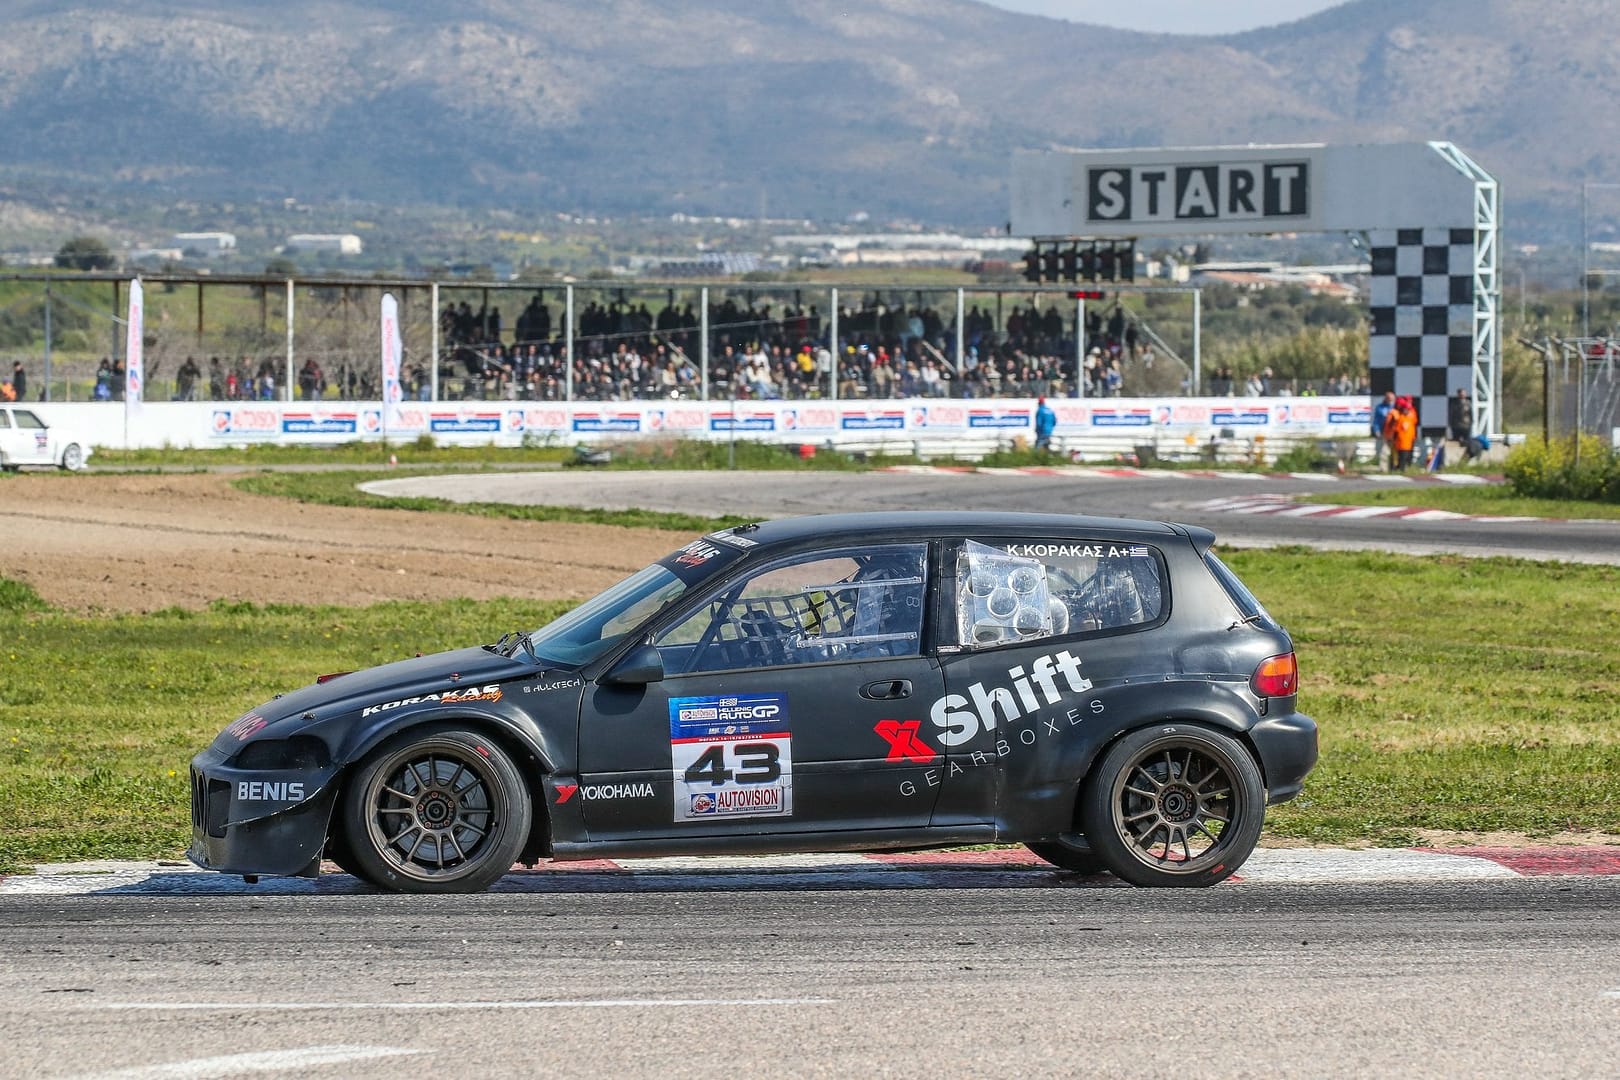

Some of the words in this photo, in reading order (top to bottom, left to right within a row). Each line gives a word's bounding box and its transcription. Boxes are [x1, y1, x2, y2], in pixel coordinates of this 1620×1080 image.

[1095, 165, 1300, 218] START
[362, 684, 501, 719] KORAKAS
[719, 711, 752, 720] AUTO
[752, 705, 780, 718] GP
[899, 699, 1106, 797] GEARBOXES
[684, 743, 782, 786] 43
[237, 782, 305, 801] BENIS
[580, 783, 655, 801] YOKOHAMA
[718, 789, 778, 808] AUTOVISION
